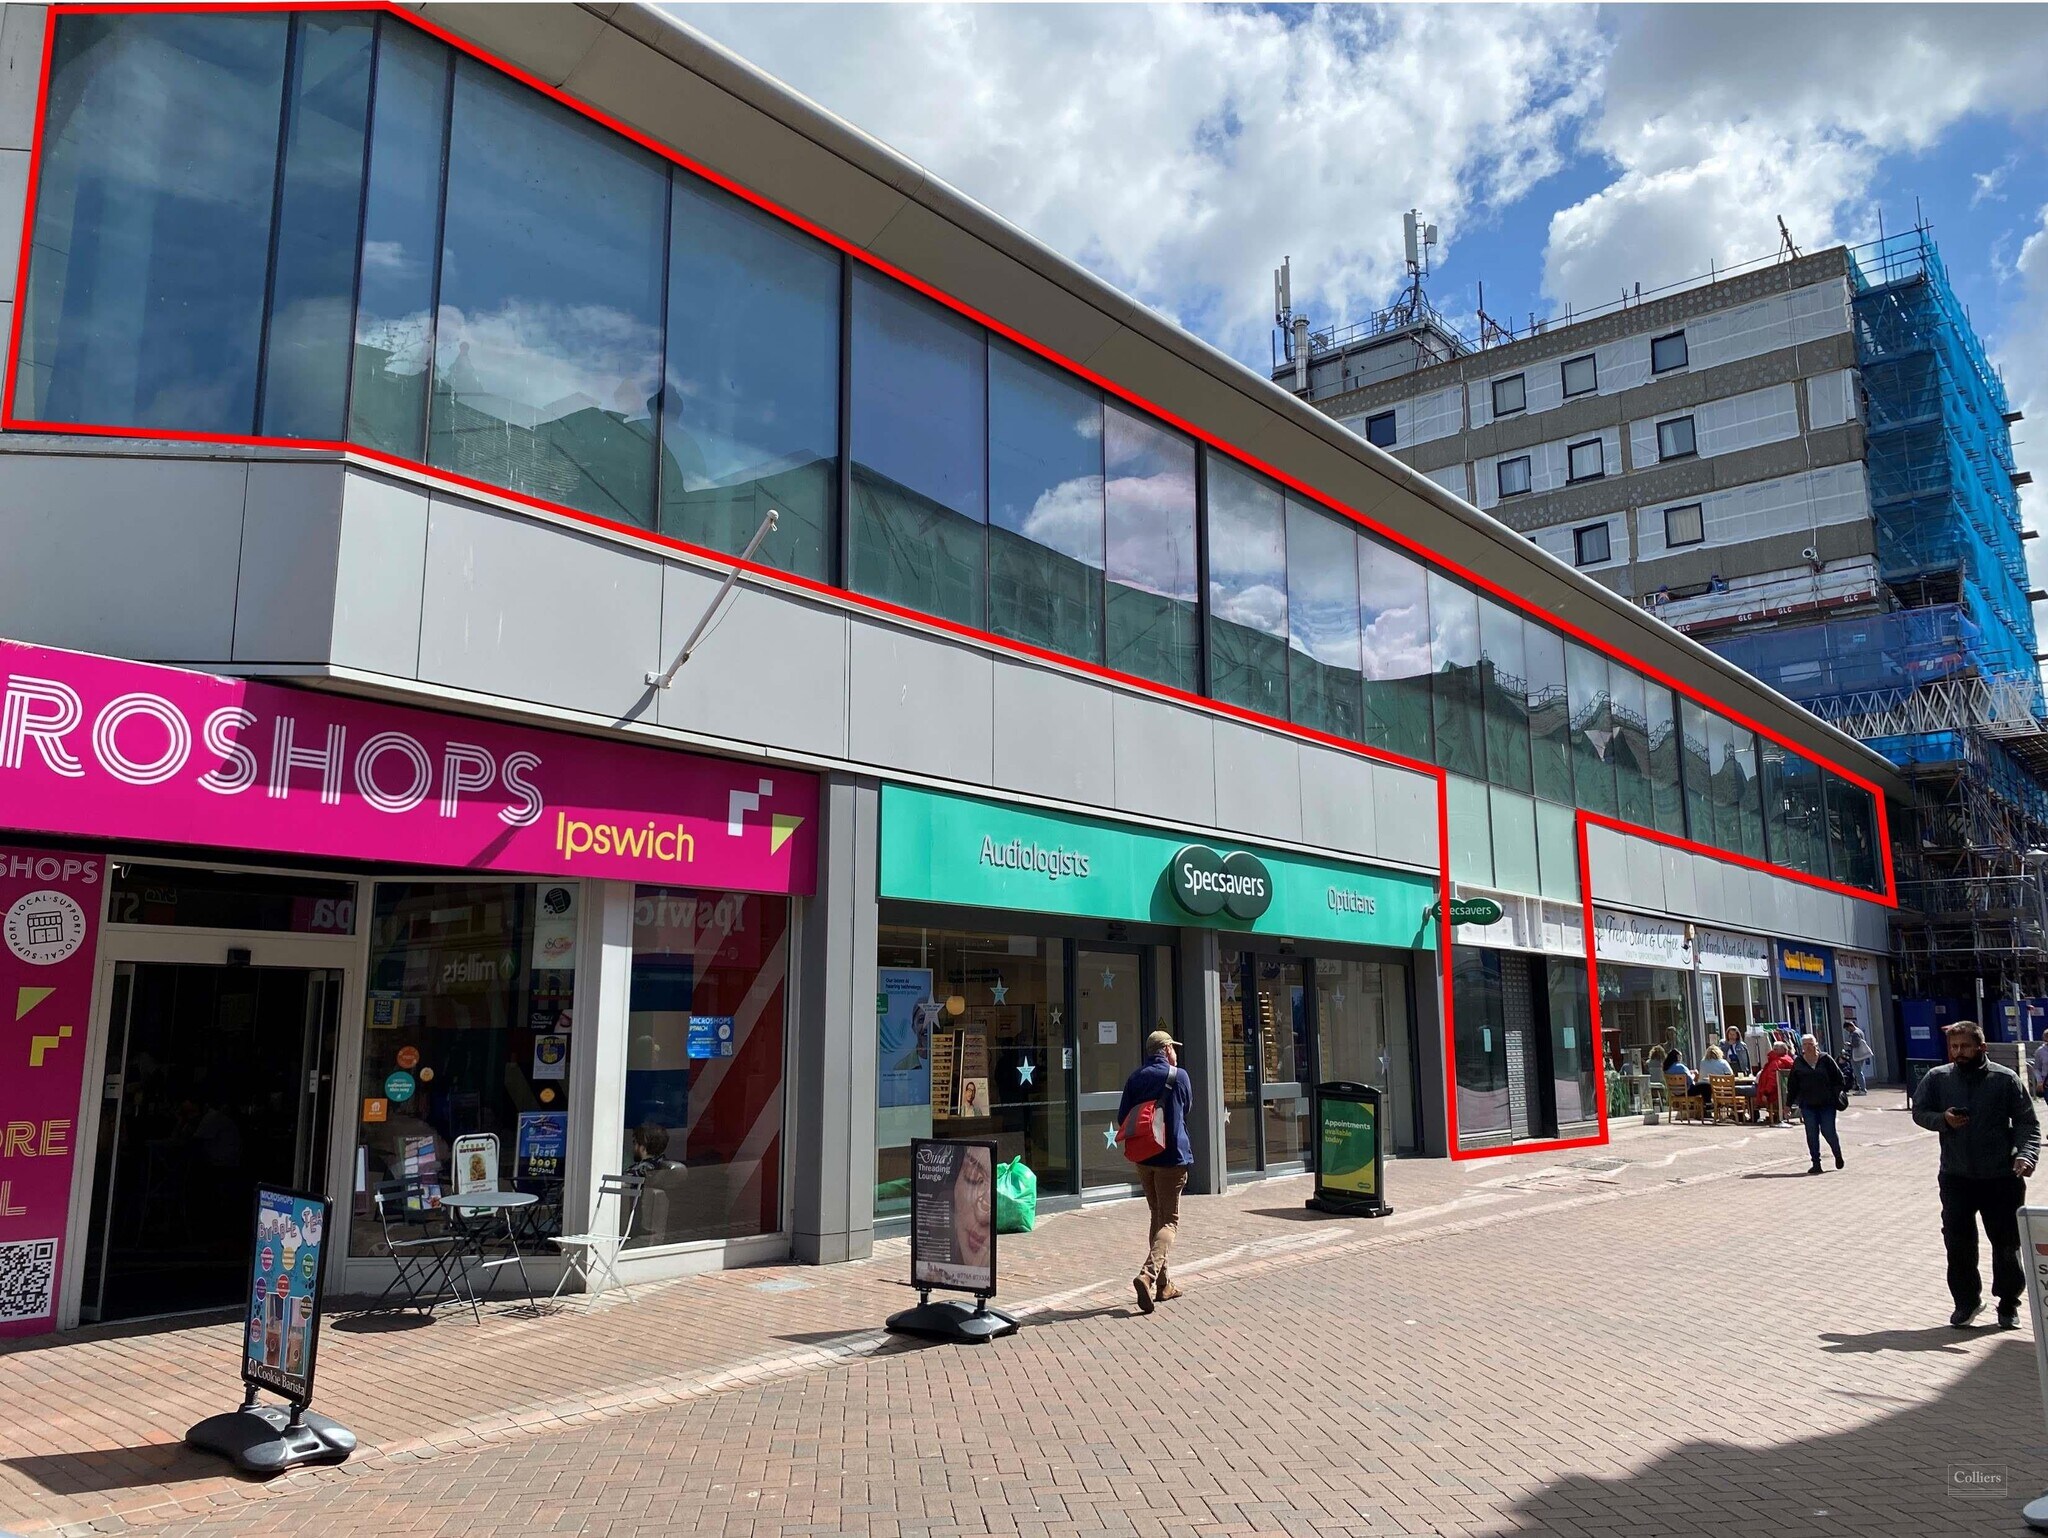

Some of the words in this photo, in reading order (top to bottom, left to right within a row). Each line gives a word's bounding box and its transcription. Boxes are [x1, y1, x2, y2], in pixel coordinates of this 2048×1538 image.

[1844, 594, 1859, 602] GLC
[1738, 613, 1752, 622] GLC
[1778, 606, 1792, 614] GLC
[1677, 624, 1691, 632] GLC
[0, 674, 543, 827] ROSHOPS
[557, 812, 694, 862] Ipswich
[979, 834, 1091, 880] Audiologists
[1184, 862, 1265, 898] Specsavers
[14, 894, 47, 916] LOCAL
[1326, 887, 1376, 916] Opticians
[1437, 905, 1492, 916] Secsavers
[1605, 914, 1628, 943] Fresh
[1630, 919, 1648, 947] Start
[1649, 928, 1656, 951] &
[1657, 924, 1679, 958] Coffee
[1702, 932, 1720, 957] Fresh
[1722, 935, 1736, 959] Start
[1324, 1119, 1371, 1130] Appointments
[1324, 1128, 1352, 1137] available
[0, 1119, 71, 1158] RE
[1324, 1135, 1344, 1146] today
[917, 1163, 951, 1174] Threading
[918, 1172, 942, 1182] Lounge
[257, 1365, 281, 1386] Cookie
[281, 1375, 305, 1397] Barista
